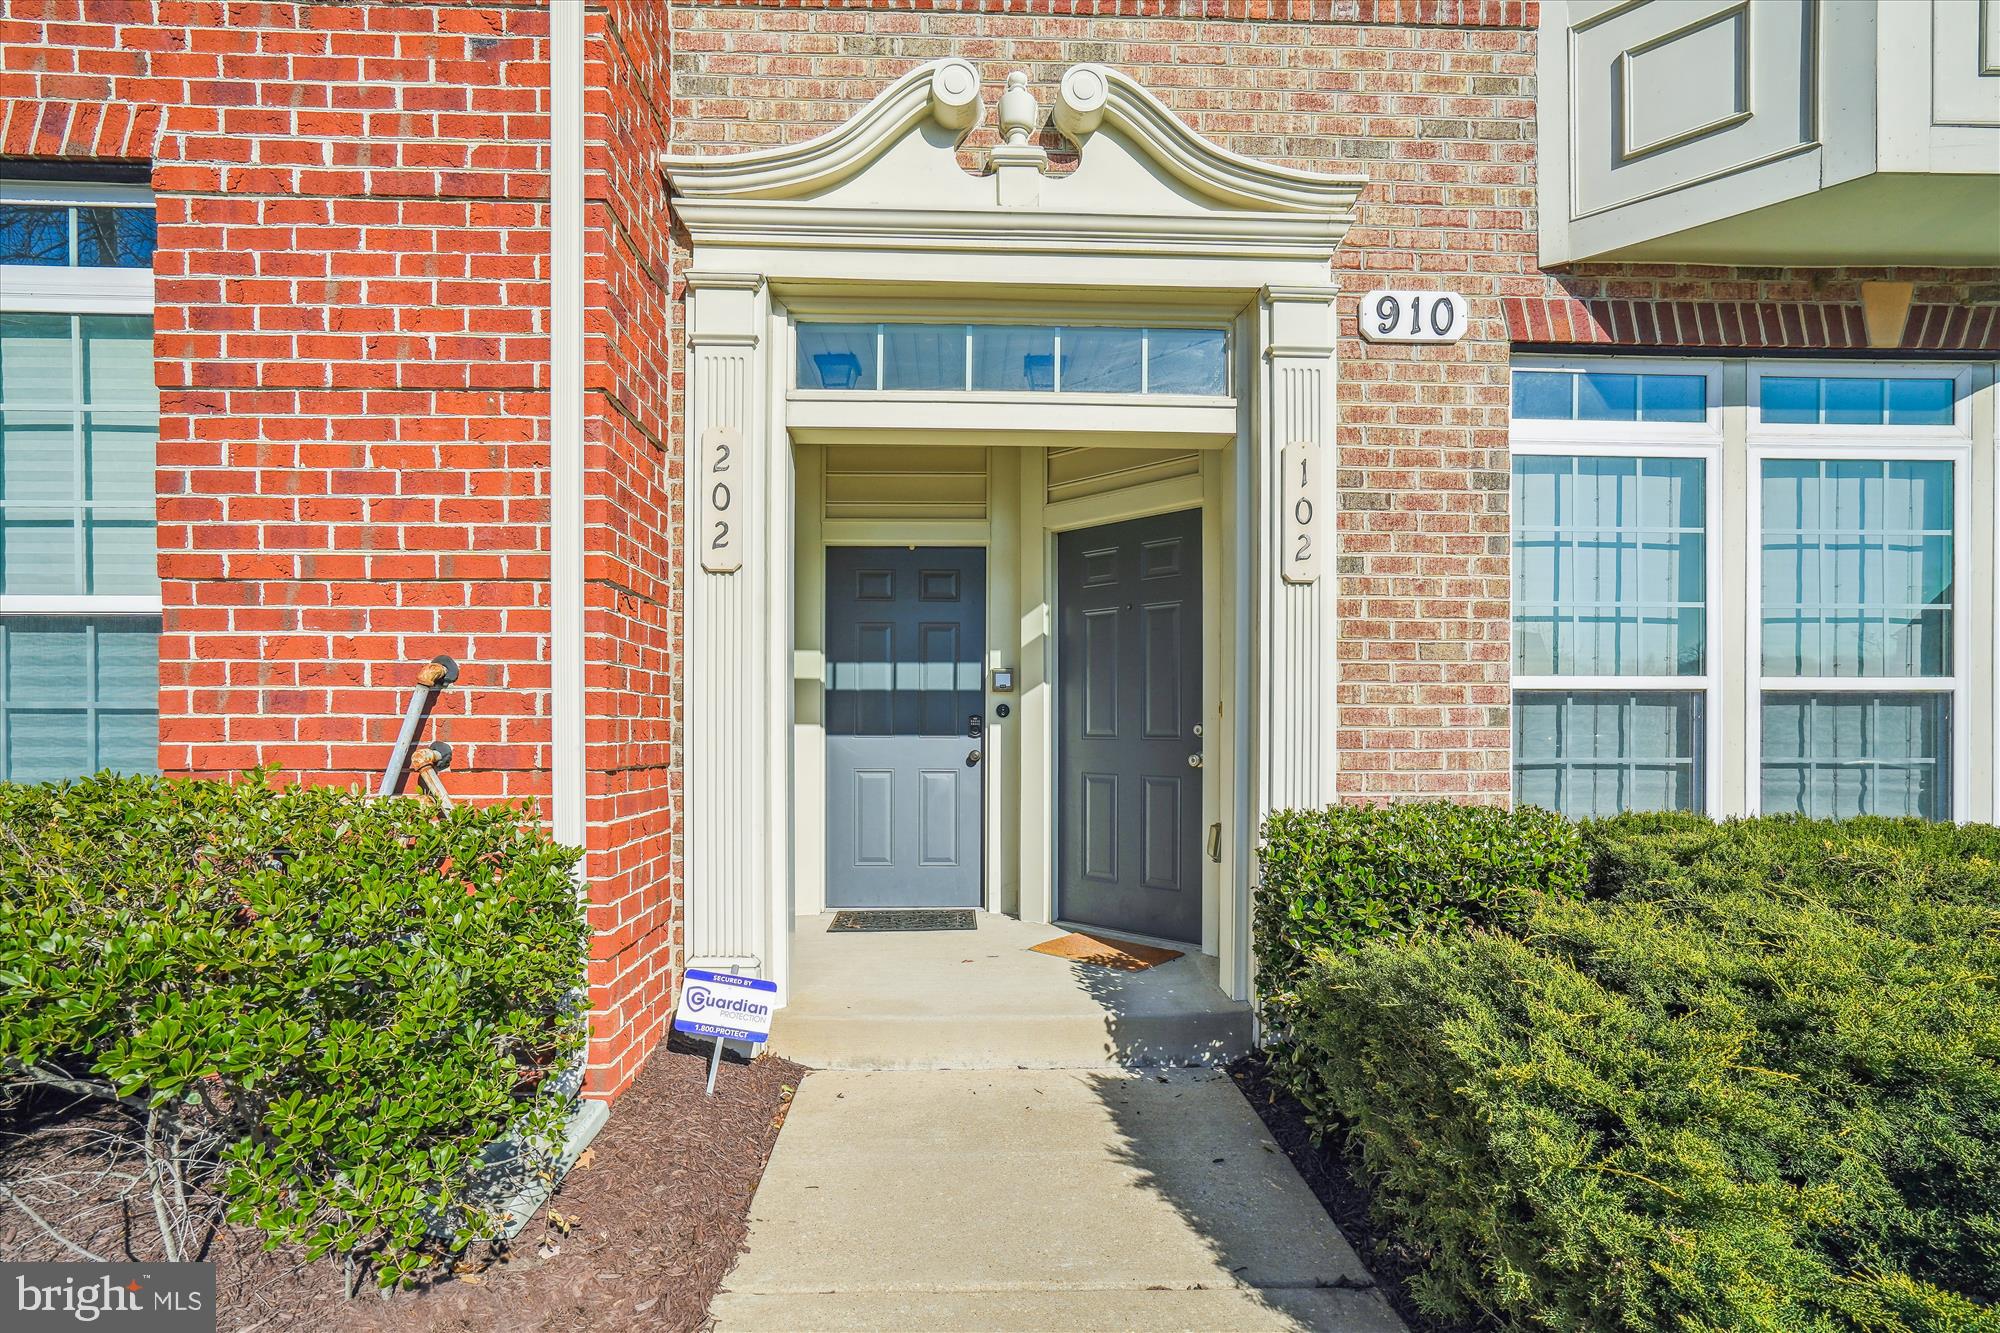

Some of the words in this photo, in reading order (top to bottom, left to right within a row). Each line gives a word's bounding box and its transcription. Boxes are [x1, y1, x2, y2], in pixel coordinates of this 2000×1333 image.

[1376, 295, 1454, 336] 910
[712, 444, 731, 550] 202
[1295, 458, 1313, 561] 102
[713, 975, 742, 985] SECURED
[690, 990, 768, 1015] Guardian
[720, 1010, 766, 1023] PROTECTION
[695, 1024, 748, 1038] 1.800.PROTECT
